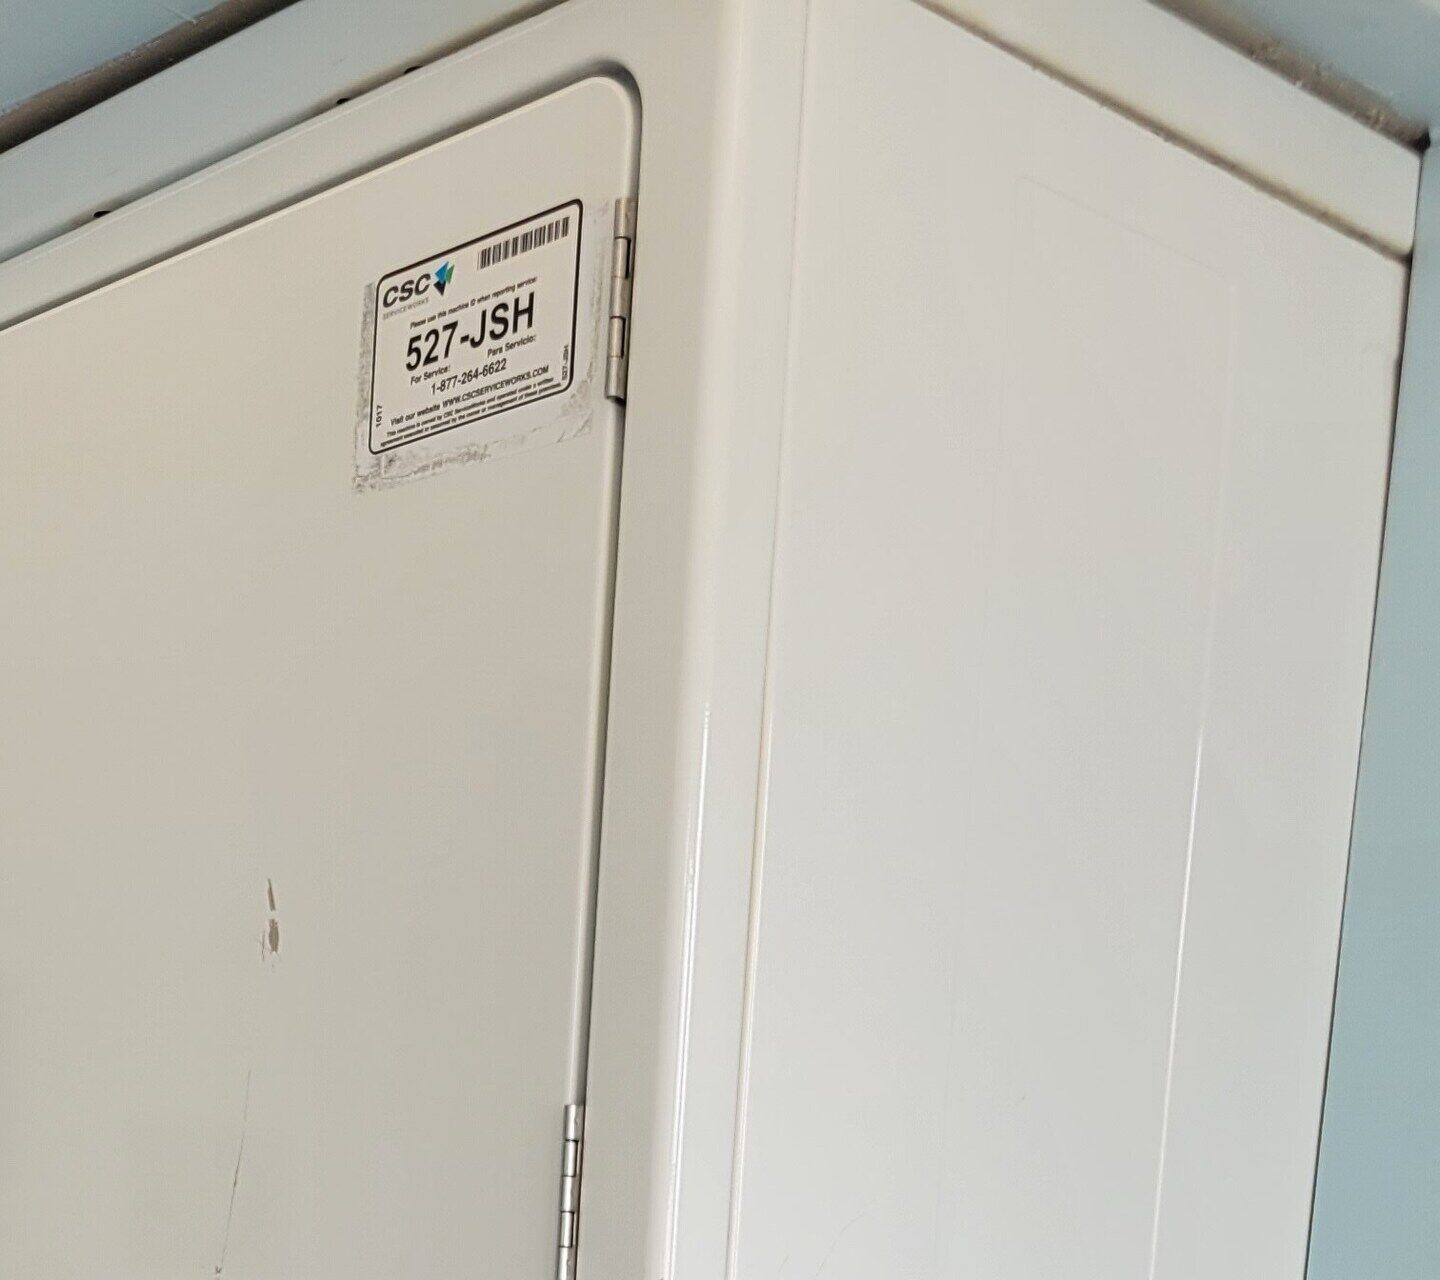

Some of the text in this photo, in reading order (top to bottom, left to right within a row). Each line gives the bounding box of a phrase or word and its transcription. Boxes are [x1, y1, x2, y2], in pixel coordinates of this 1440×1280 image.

[383, 273, 430, 308] CSC
[406, 291, 534, 371] 527-JSH
[432, 358, 507, 395] 1-877-264-6622
